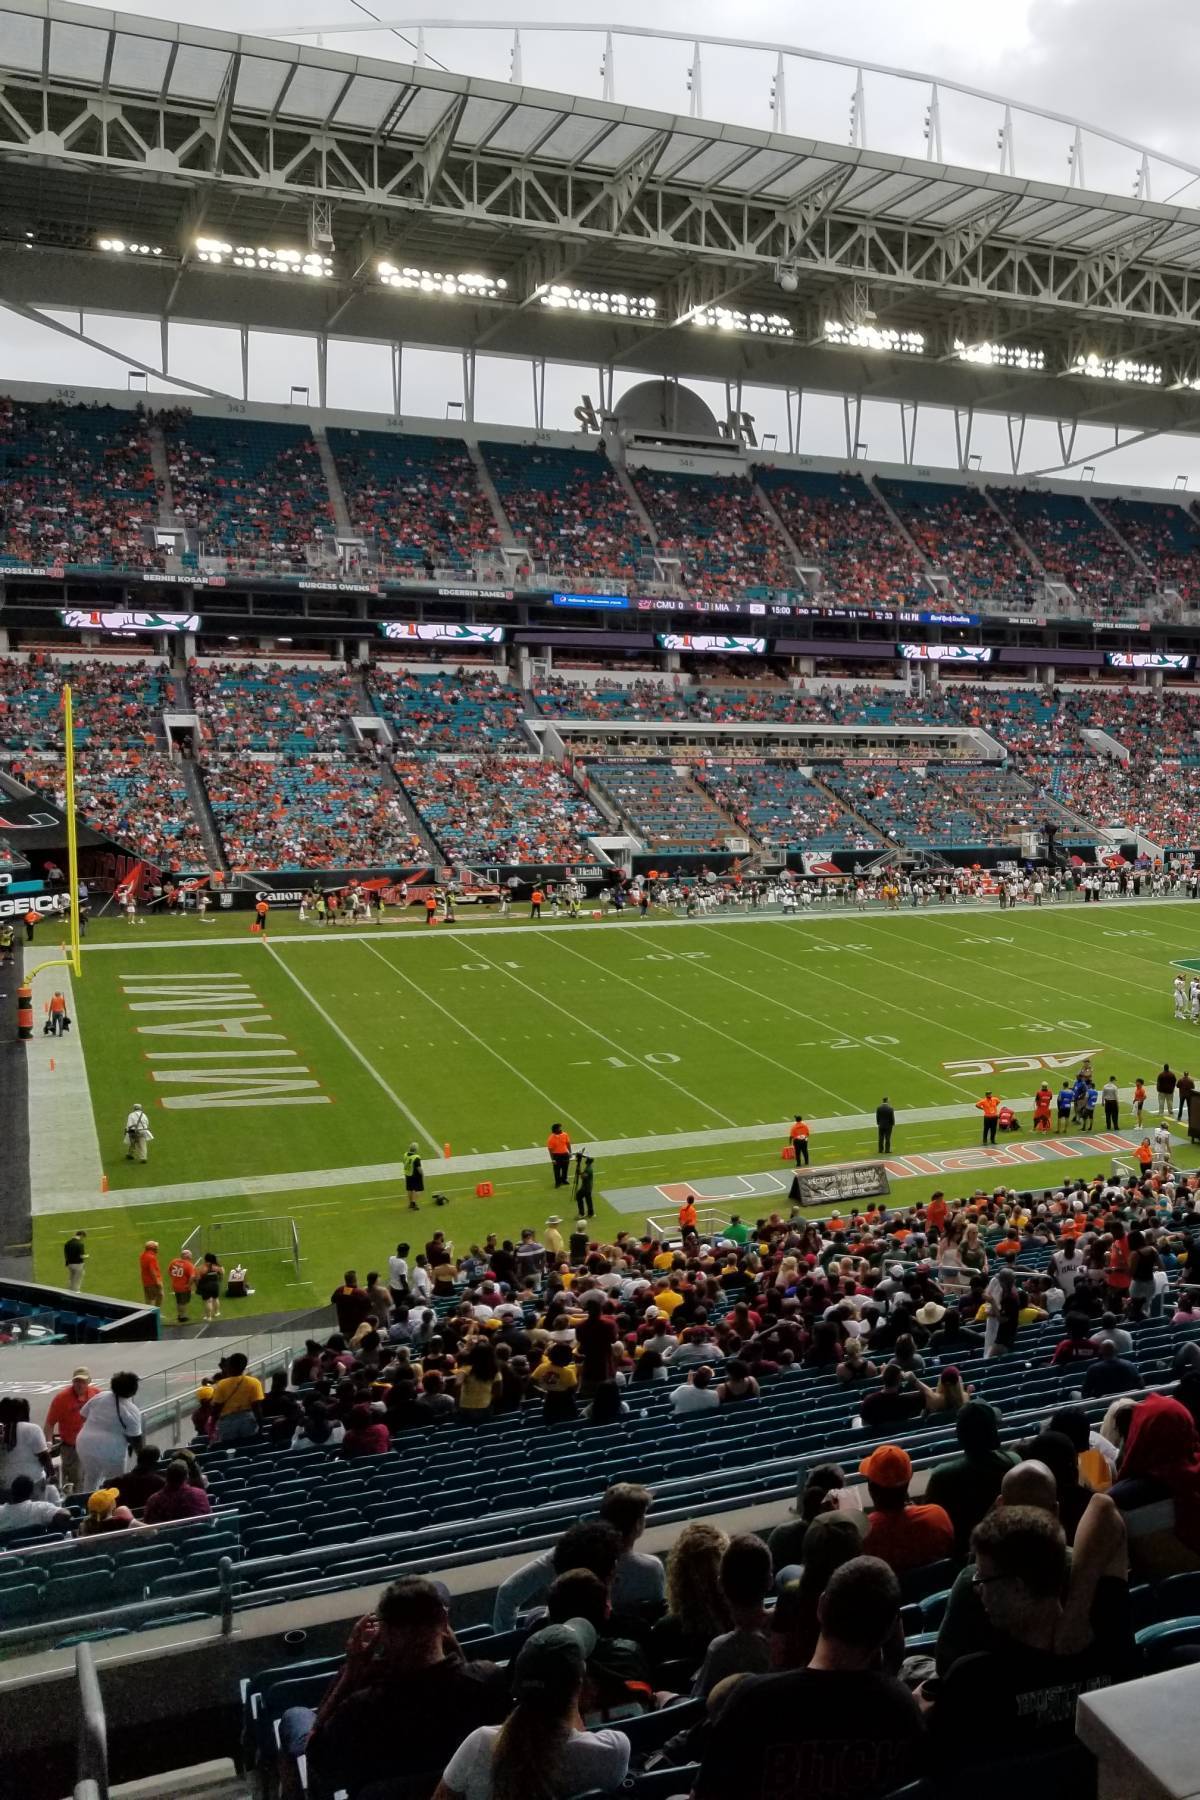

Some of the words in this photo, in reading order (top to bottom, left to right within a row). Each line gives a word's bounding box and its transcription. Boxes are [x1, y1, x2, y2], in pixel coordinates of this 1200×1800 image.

[143, 574, 176, 582] BERNIE
[177, 576, 209, 584] KOSAR
[299, 581, 338, 590] BURGESS
[339, 583, 370, 592] OWENS
[714, 604, 730, 612] MIA
[771, 606, 791, 614] 15:00
[255, 890, 303, 902] Canon
[118, 972, 333, 1110] MIAMI
[820, 1034, 900, 1050] 20
[602, 1051, 682, 1068] 10
[171, 1266, 184, 1278] 20
